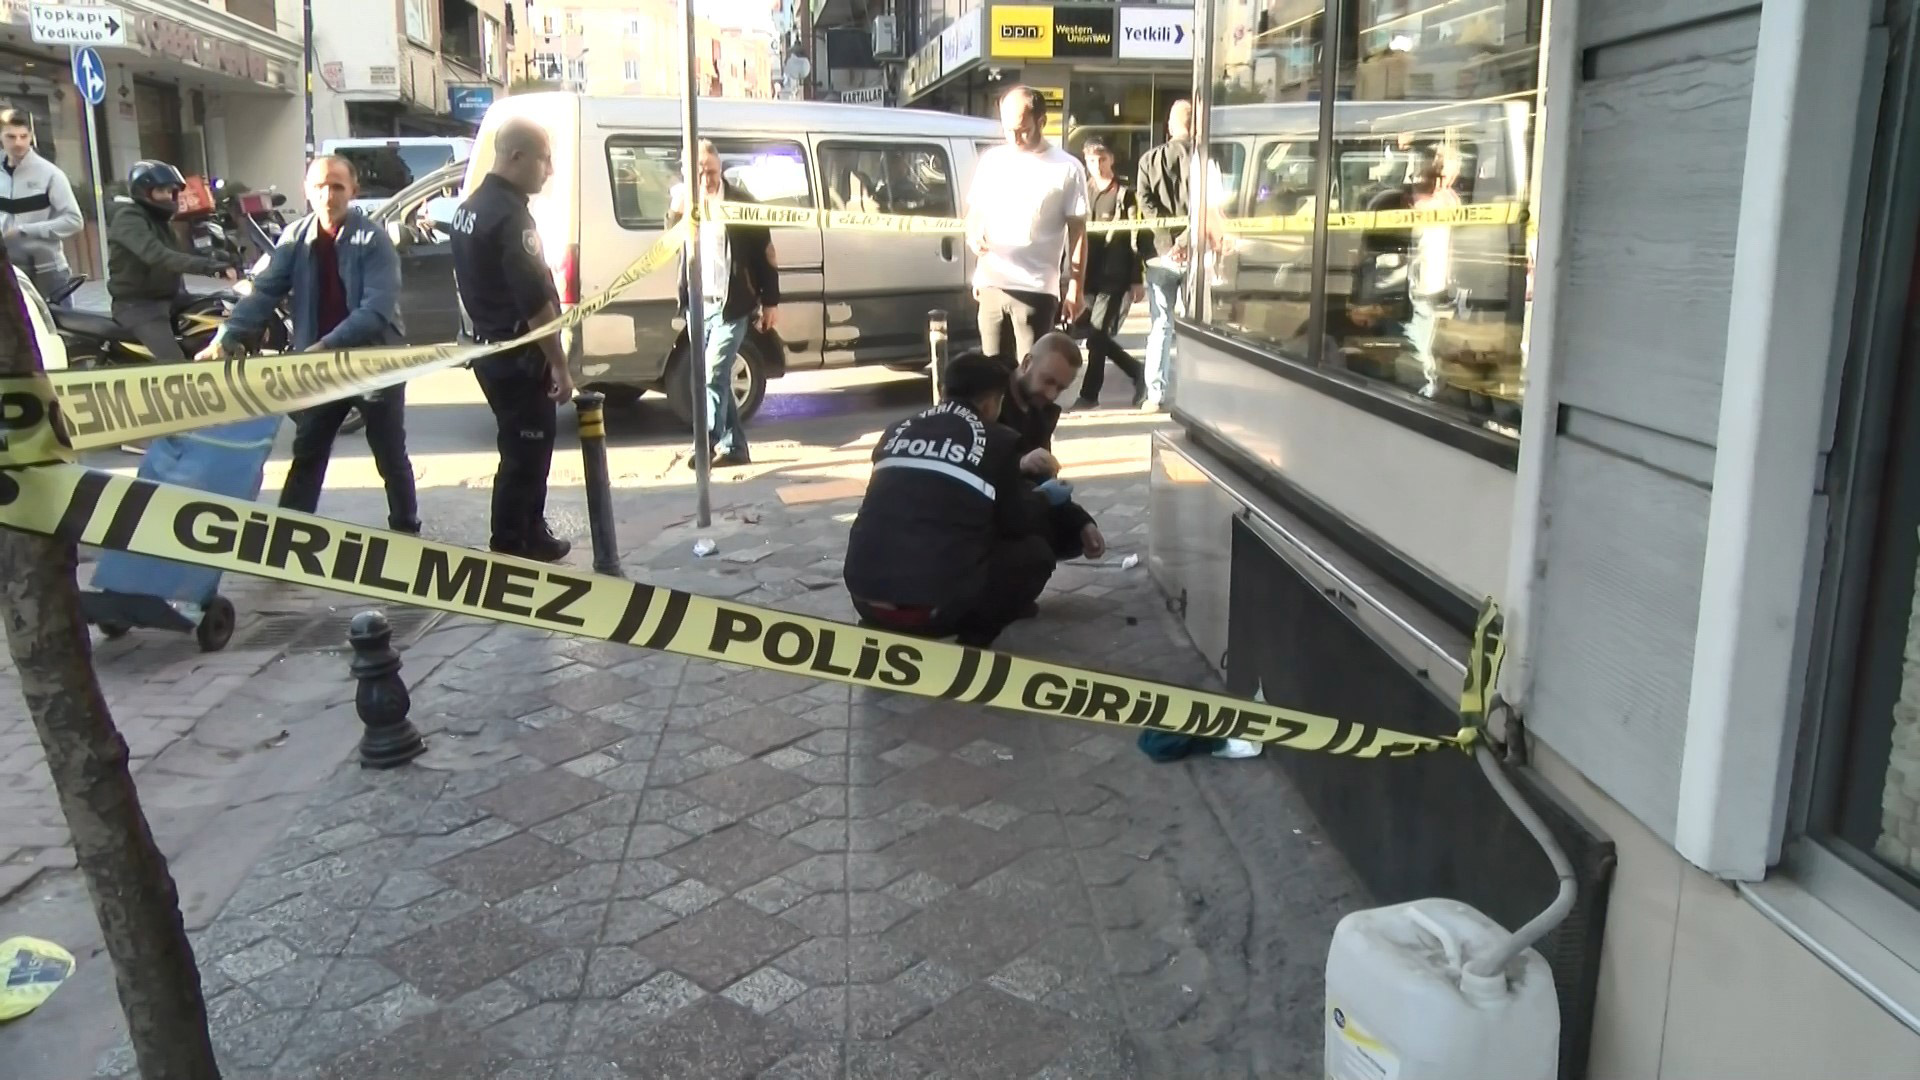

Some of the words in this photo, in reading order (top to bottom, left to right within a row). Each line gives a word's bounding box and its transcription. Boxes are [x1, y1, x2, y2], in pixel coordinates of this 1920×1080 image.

[37, 25, 103, 40] Yedikule
[1056, 24, 1093, 35] Western
[1125, 26, 1170, 41] Yetkili
[453, 208, 477, 235] OLİS
[892, 437, 967, 464] POLİS
[172, 501, 593, 627] GİRİLMEZ
[708, 606, 925, 687] POLİS
[1021, 671, 1308, 744] GİRİLMEZ
